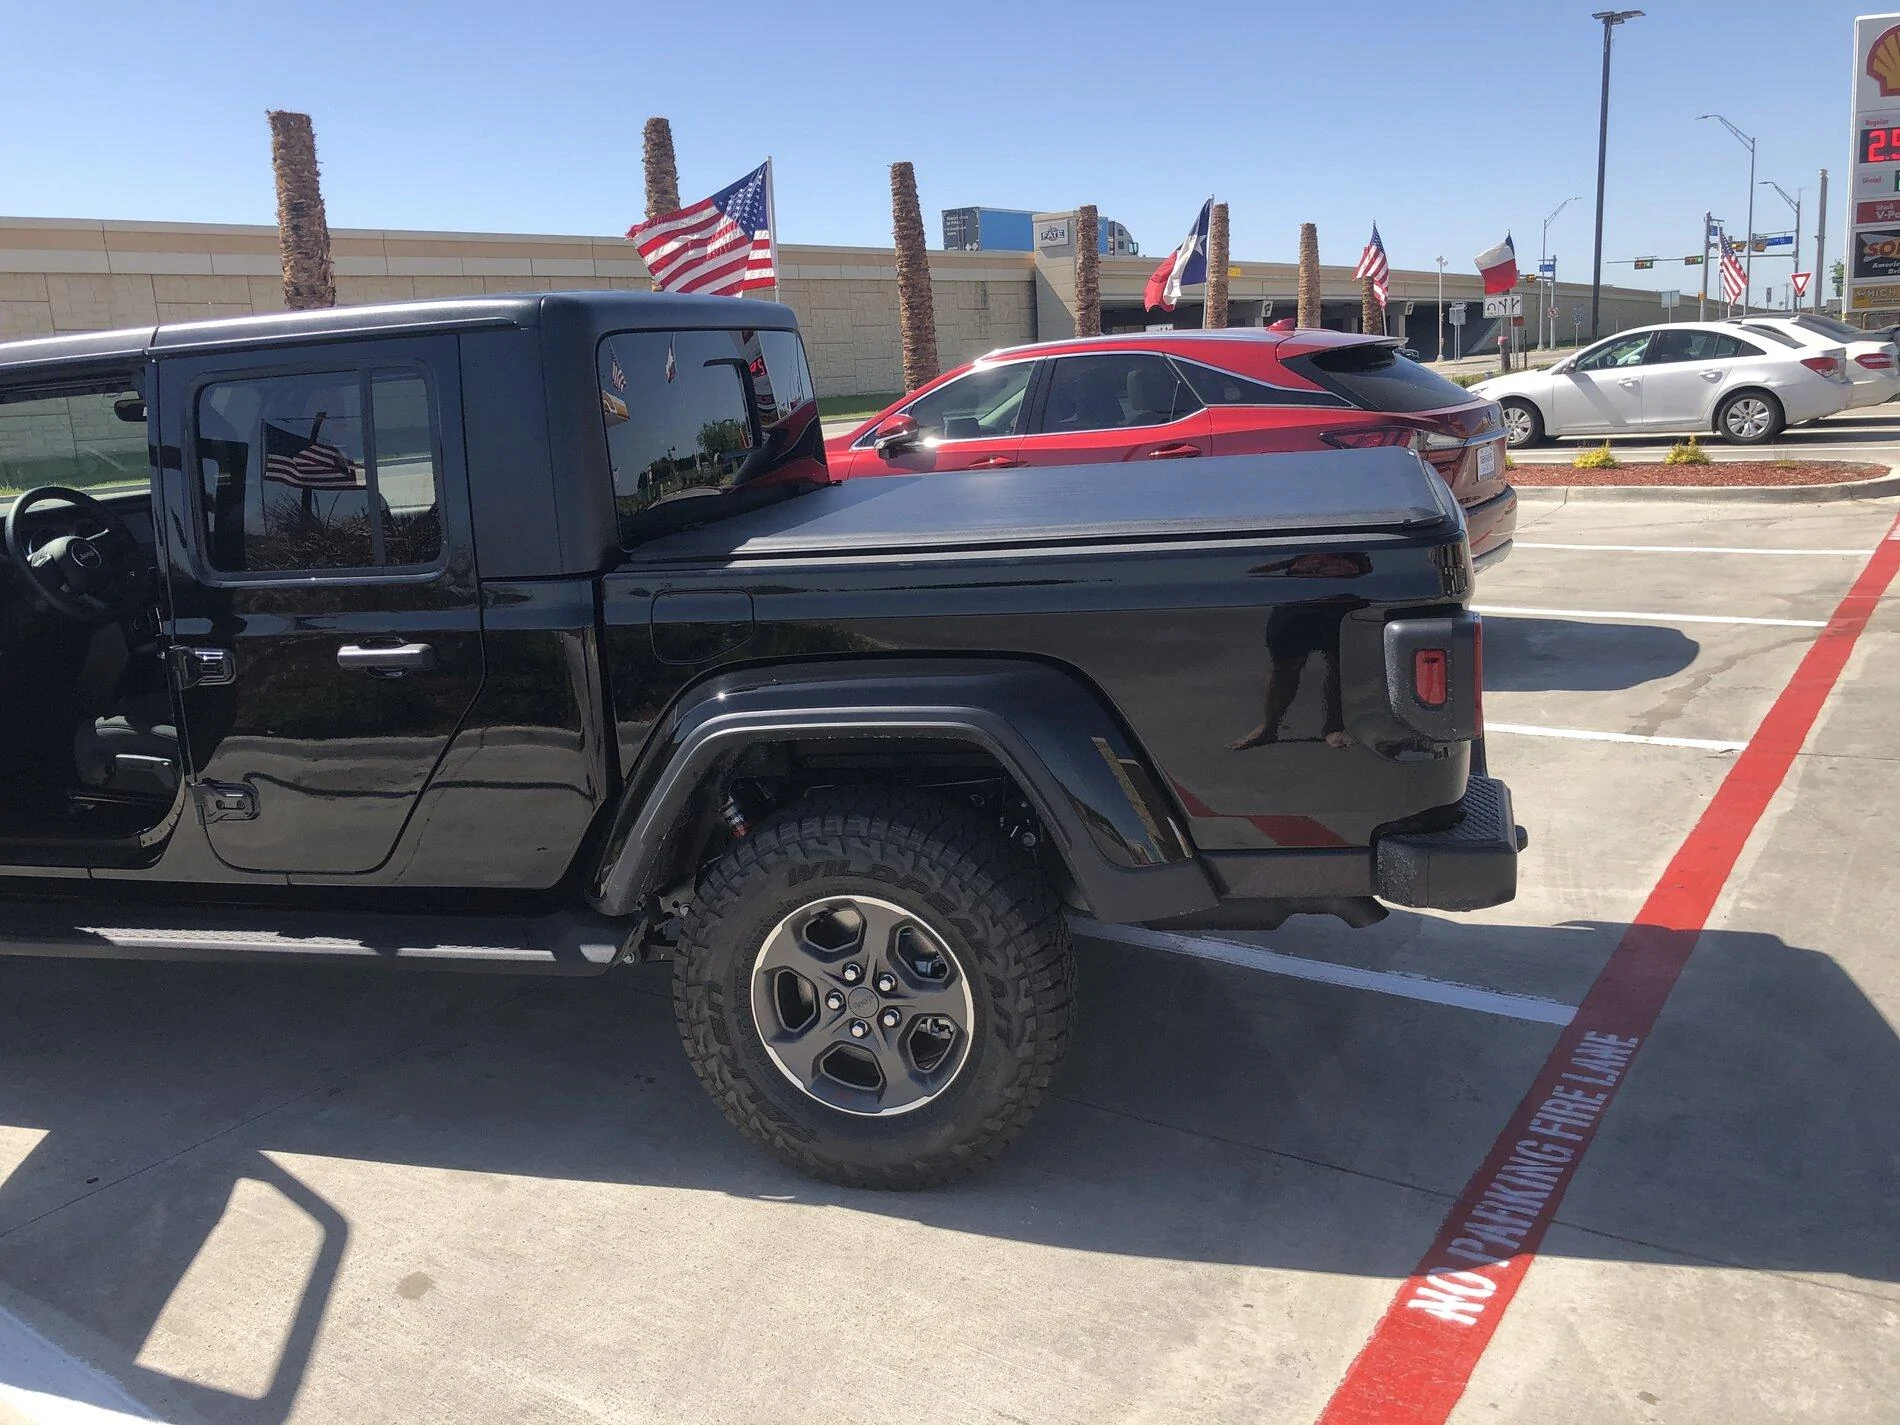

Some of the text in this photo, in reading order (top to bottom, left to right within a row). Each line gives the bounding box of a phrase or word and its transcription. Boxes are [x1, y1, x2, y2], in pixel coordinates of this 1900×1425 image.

[1862, 175, 1882, 184] Diesel
[1876, 203, 1894, 211] Shell
[1041, 229, 1064, 241] FATE
[1407, 1030, 1639, 1327] NO PARKING FIRE LANE
